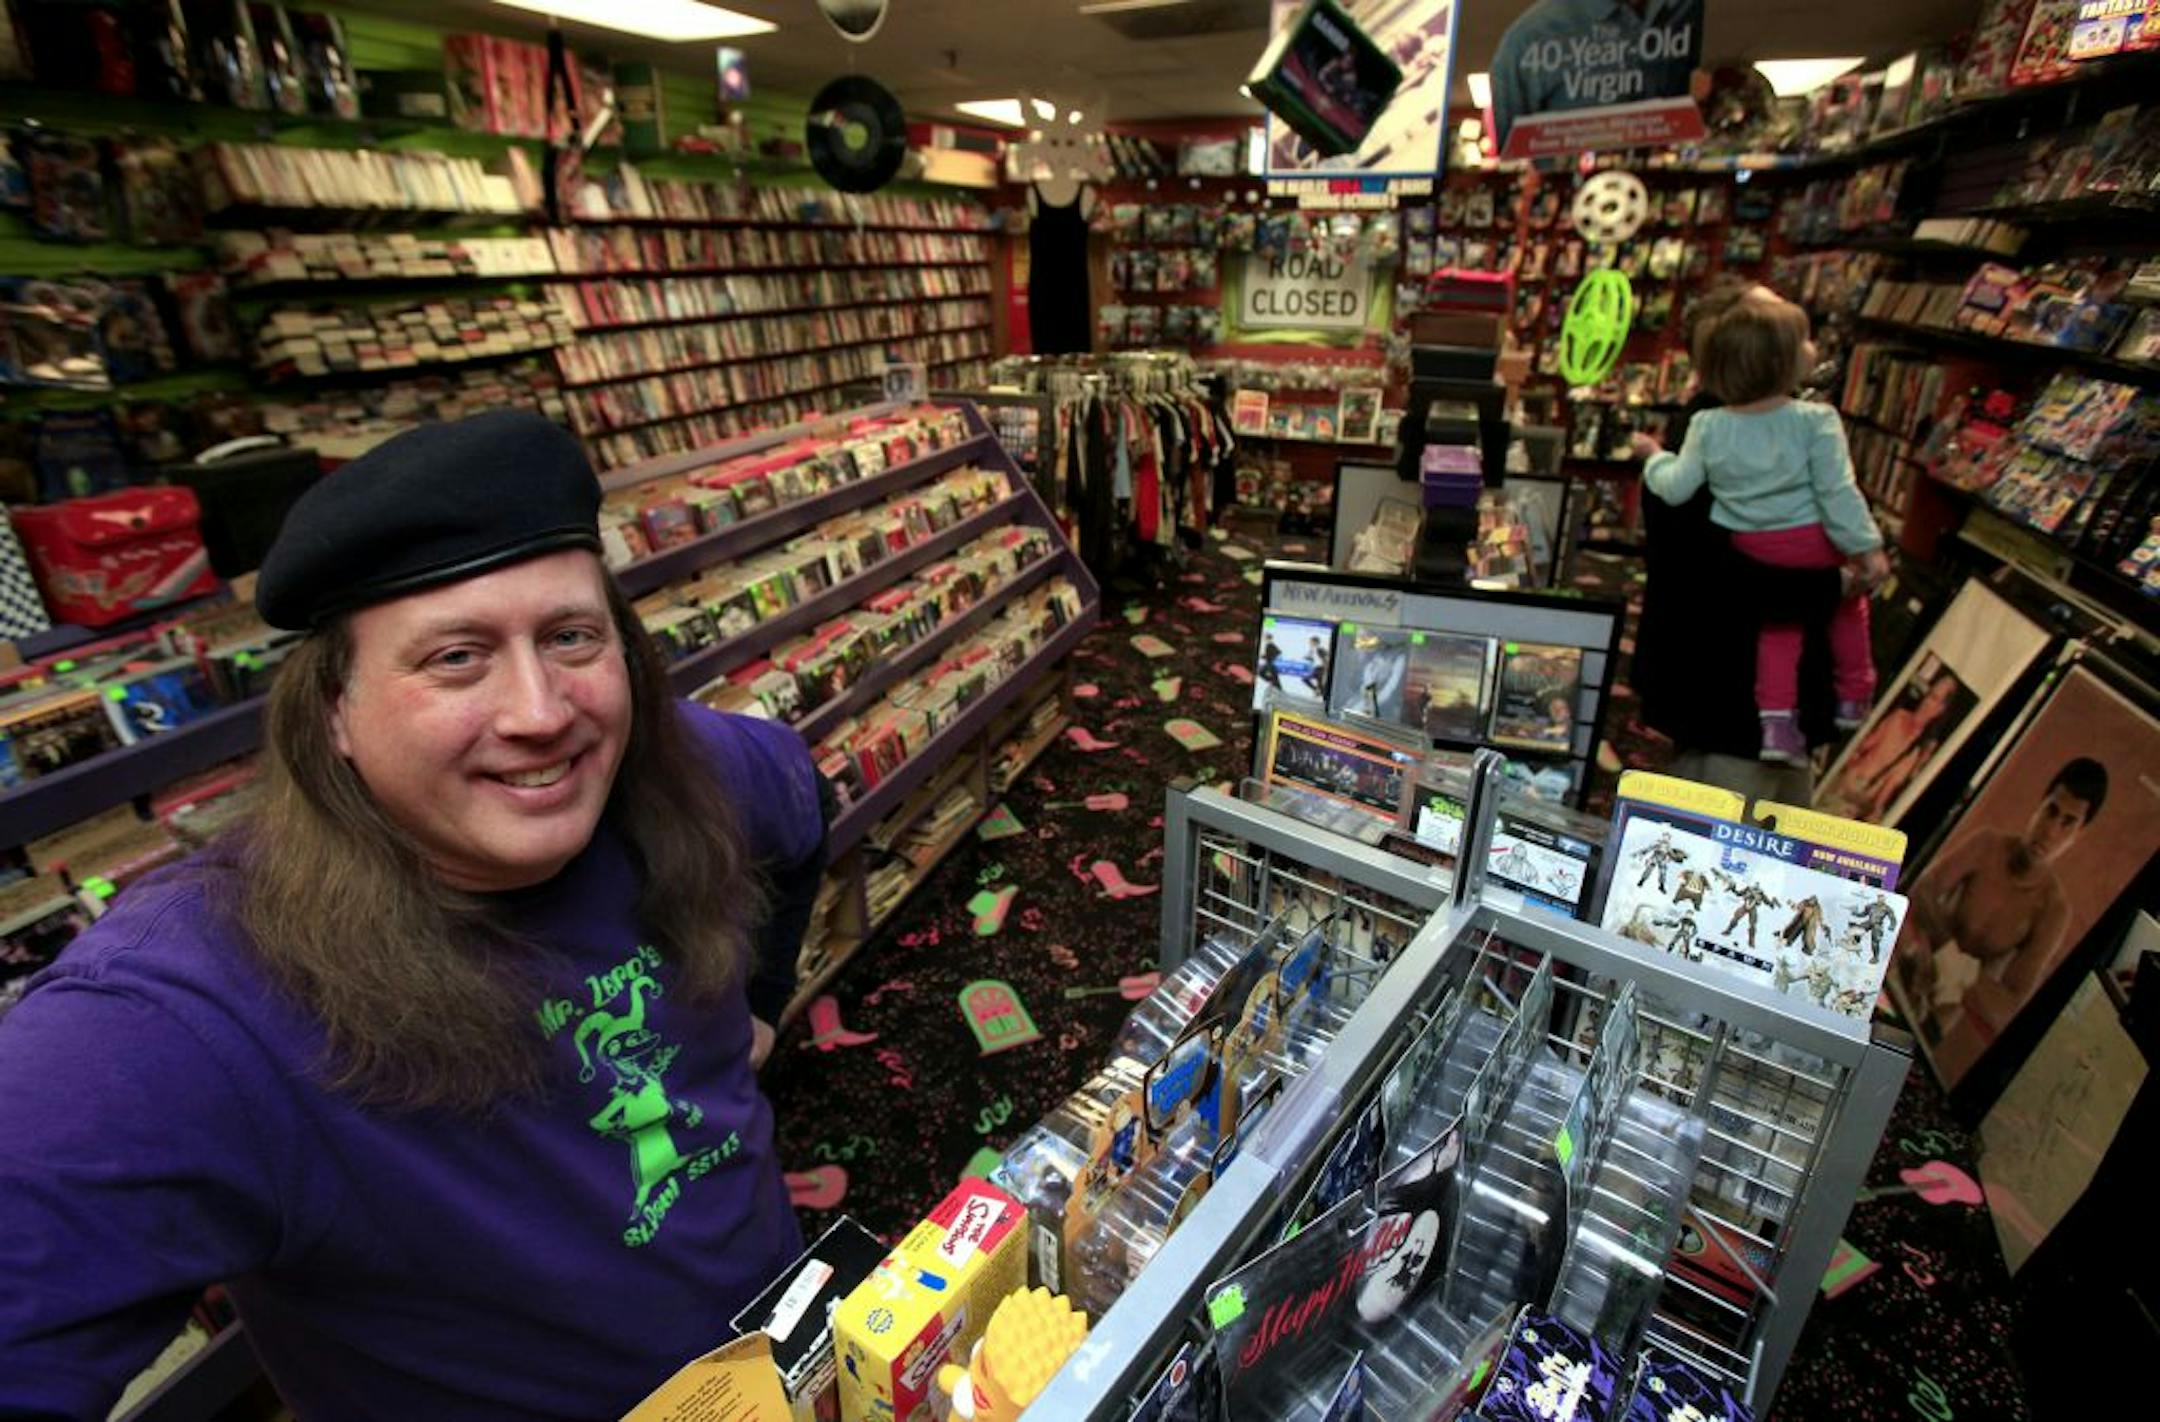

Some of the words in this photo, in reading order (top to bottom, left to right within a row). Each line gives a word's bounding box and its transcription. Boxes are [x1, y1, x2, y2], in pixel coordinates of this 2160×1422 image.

[1520, 25, 1692, 72] 40-Year-Old
[1563, 62, 1643, 102] Virgin
[1268, 252, 1344, 280] ROAD
[1252, 288, 1358, 316] CLOSED
[1717, 824, 1794, 857] DESIRE
[1238, 1276, 1335, 1368] Sleepy
